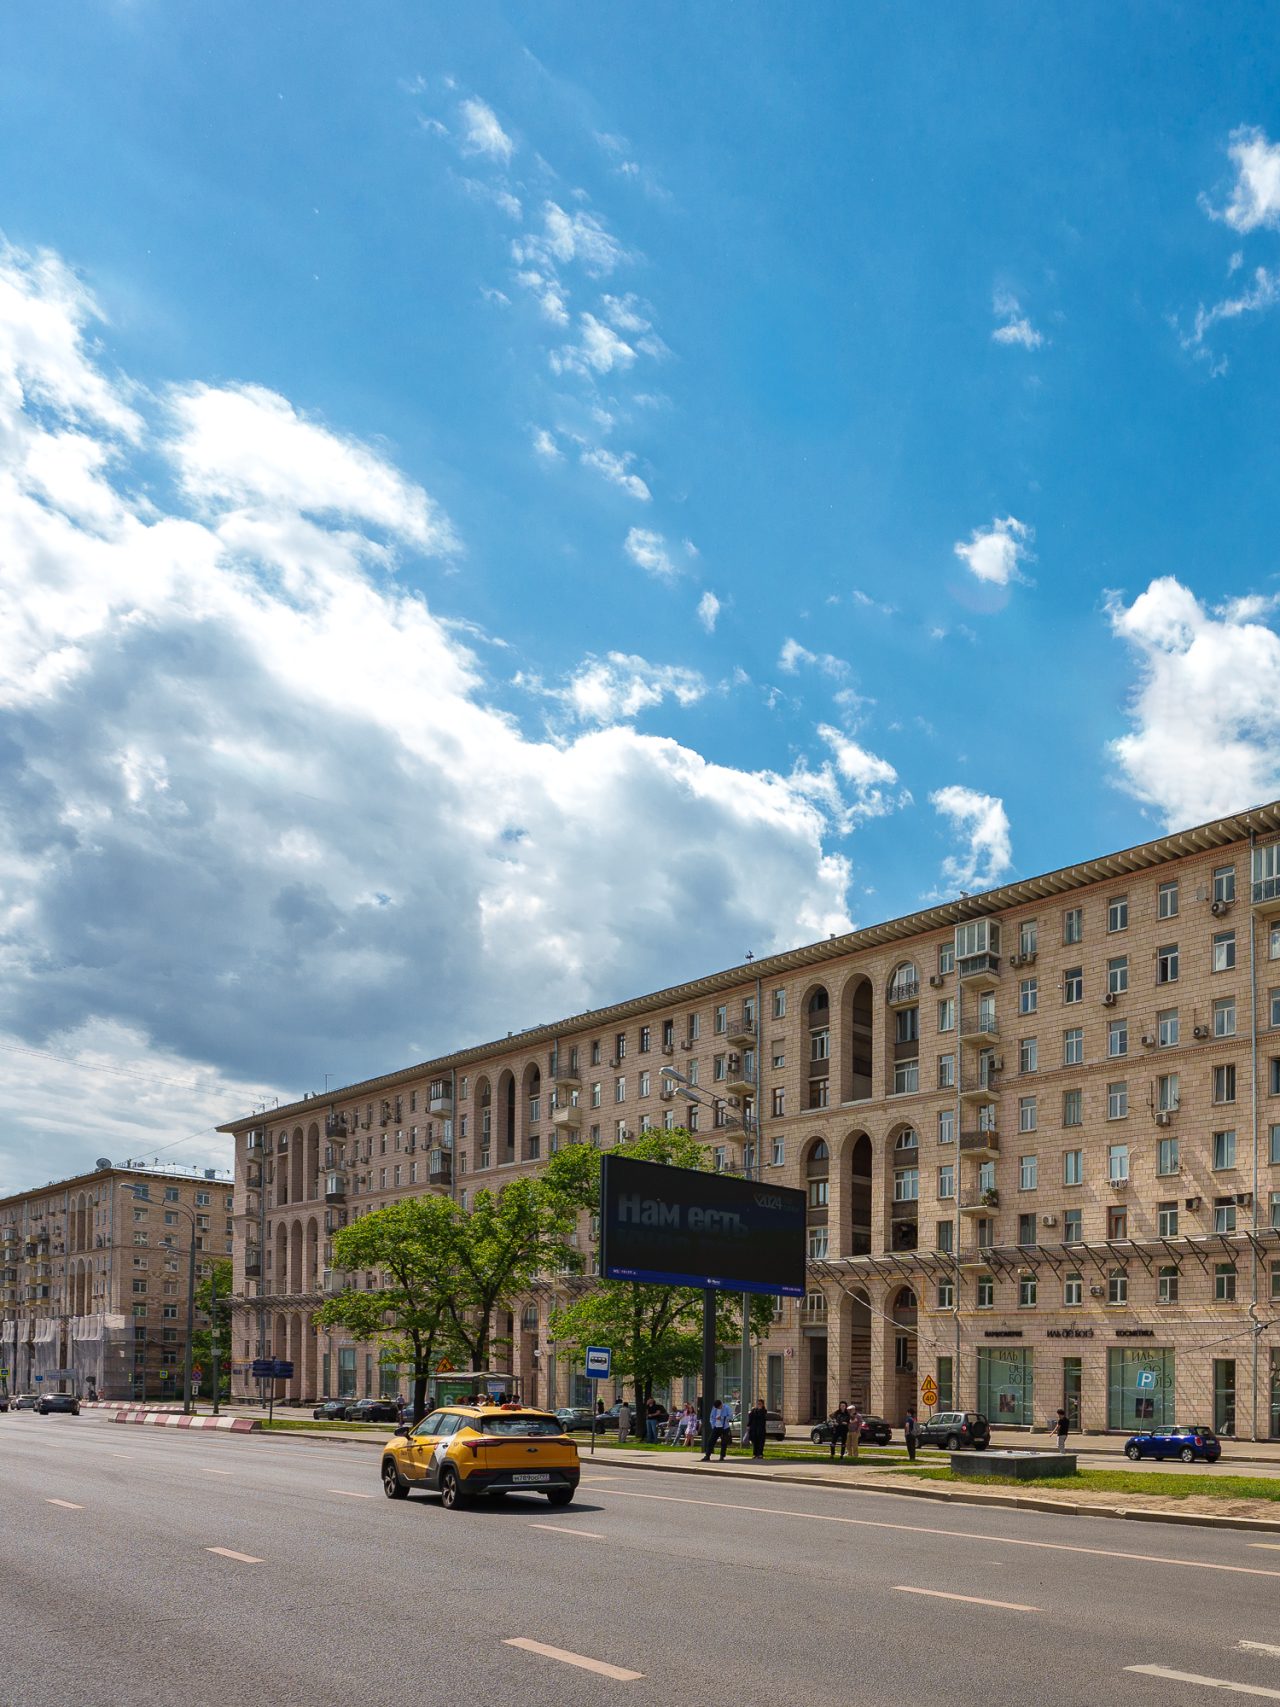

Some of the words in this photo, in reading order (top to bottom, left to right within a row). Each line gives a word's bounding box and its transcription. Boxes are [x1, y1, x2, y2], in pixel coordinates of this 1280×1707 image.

[758, 1196, 783, 1210] 2024
[617, 1193, 679, 1229] Нам
[687, 1205, 749, 1237] есть
[1047, 1330, 1061, 1338] ИЛЬ
[1000, 1351, 1018, 1361] ИЛЬ
[1131, 1351, 1154, 1361] ИЛЬ
